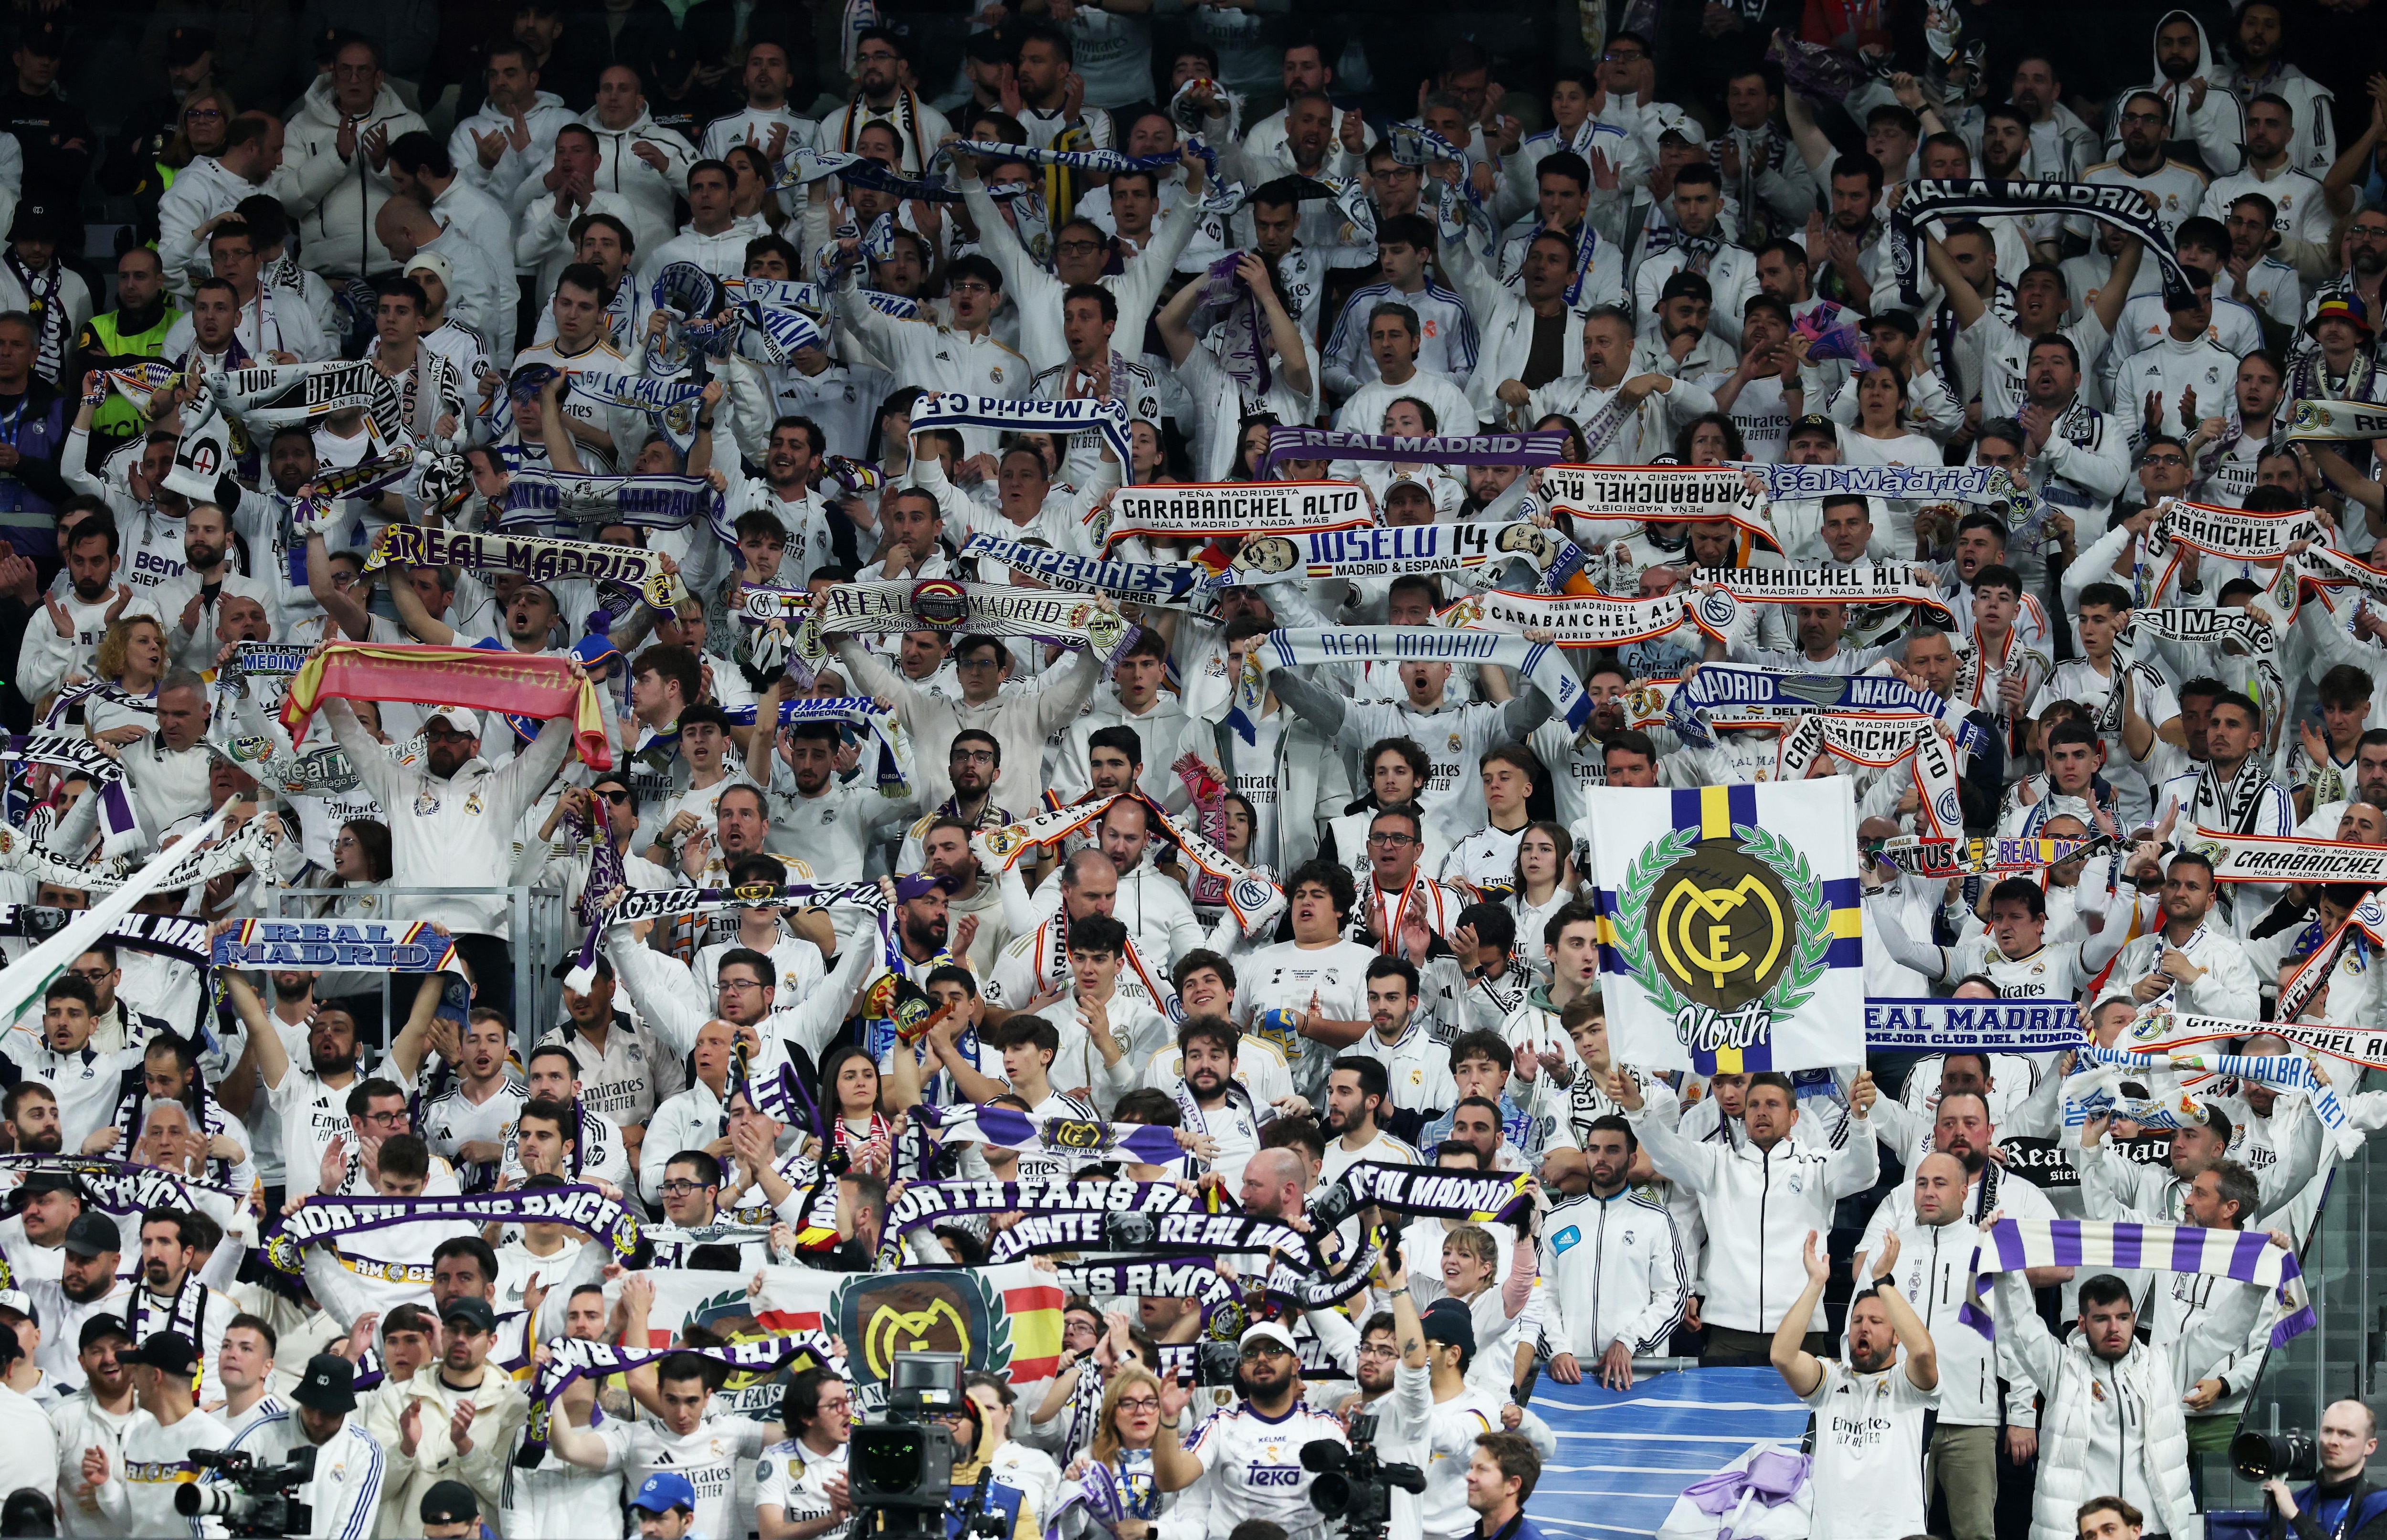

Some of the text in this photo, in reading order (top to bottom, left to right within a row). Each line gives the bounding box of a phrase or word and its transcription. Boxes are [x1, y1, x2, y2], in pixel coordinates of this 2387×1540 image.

[1902, 180, 1992, 207] HALA
[1206, 222, 1222, 241] hp
[472, 360, 488, 379] hp
[237, 369, 277, 395] JUDE
[603, 374, 624, 393] LA
[333, 395, 361, 408] EN EL
[978, 398, 1083, 418] Madrid
[1139, 398, 1157, 417] hp
[1091, 399, 1132, 443] Real
[1728, 414, 1791, 427] mirates
[1304, 432, 1522, 453] REAL MADRID
[1748, 428, 1780, 441] BETTER
[1559, 471, 1584, 480] MÁS
[1634, 474, 1644, 482] Y
[1648, 473, 1696, 482] MADRID
[1847, 466, 1983, 492] Madrid
[1179, 488, 1300, 498] PEÑA MADRIDISTA
[1539, 478, 1757, 510] CARABANCHEL ALTO
[2226, 483, 2242, 495] FLY
[1123, 492, 1358, 518] CARABANCHEL ALTO
[1589, 504, 1704, 515] PEÑA MADRIDISTA
[1152, 520, 1185, 528] HALA
[1191, 519, 1240, 528] MADRID
[1303, 516, 1329, 524] MÁS
[2176, 505, 2288, 526] PEÑA MADRIDISTA
[398, 525, 648, 581] REAL MADRID
[515, 536, 644, 556] EQUIPO DEL SIGLO
[1307, 525, 1488, 564] JOSELU 14
[2248, 546, 2281, 555] NADA
[969, 535, 1174, 594] CAMPEONES
[1336, 558, 1458, 577] MADRID & ESPAÑA
[1548, 544, 1576, 586] JOSELU
[2344, 563, 2371, 580] PEÑA
[130, 572, 166, 587] SIEM
[973, 548, 1157, 604] COMO NO TE VOY A QUERER
[1476, 580, 1493, 589] UEFA
[1691, 567, 1861, 587] CARABANCHEL
[1760, 584, 1898, 596] MADRID Y NADA MÁS
[836, 589, 1060, 624] REAL MADRID
[1574, 602, 1636, 612] MADRIDISTA
[871, 617, 1005, 631] ESTADIO SANTIAGO BERNABEU
[1491, 607, 1637, 627] CARABANCHEL
[1612, 627, 1643, 637] NADA
[1649, 617, 1672, 630] MÁS
[1322, 633, 1498, 657] REAL MADRID
[2159, 628, 2211, 642] Real Madrid
[243, 654, 304, 670] MEDINA
[1967, 660, 1976, 690] HALA
[1561, 684, 1576, 704] adidas
[1689, 671, 1773, 704] MADRID
[794, 709, 850, 718] CAMPEONES
[1773, 707, 1797, 717] DEL
[1822, 717, 1848, 727] EÑA
[1827, 734, 1869, 758] MADRID
[1915, 725, 1948, 779] ALTO
[303, 778, 347, 790] Santiago
[2319, 779, 2327, 798] COPA
[1888, 838, 1911, 847] FINALE
[1999, 839, 2044, 864] REAL
[2297, 846, 2387, 857] PEÑA MADRIDIS
[29, 841, 92, 875] Real
[1198, 842, 1243, 875] ALTO
[2234, 851, 2383, 874] CARABANCHEL
[91, 869, 201, 887] UEFA LEAGUE
[260, 923, 393, 944] REAL
[228, 942, 430, 967] MADRID
[1676, 1000, 1771, 1058] North
[1865, 1007, 1933, 1031] EAL
[1866, 1032, 2084, 1044] MEJOR CLUB DEL MUNDO
[2291, 1025, 2369, 1037] MADRIDISTA
[2218, 1055, 2303, 1087] VILLALBA
[604, 1095, 636, 1112] BETTER
[585, 1146, 605, 1167] hp
[1053, 1146, 1099, 1156] NORTH FANS
[1025, 1181, 1138, 1212] FANS
[1350, 1165, 1515, 1213] REAL MADRID
[520, 1192, 622, 1234] RMCF
[1158, 1214, 1244, 1245] REAL
[355, 1261, 433, 1282] RM CF
[742, 1385, 782, 1408] FANS
[685, 1467, 730, 1484] irates
[696, 1484, 723, 1499] ETTER
